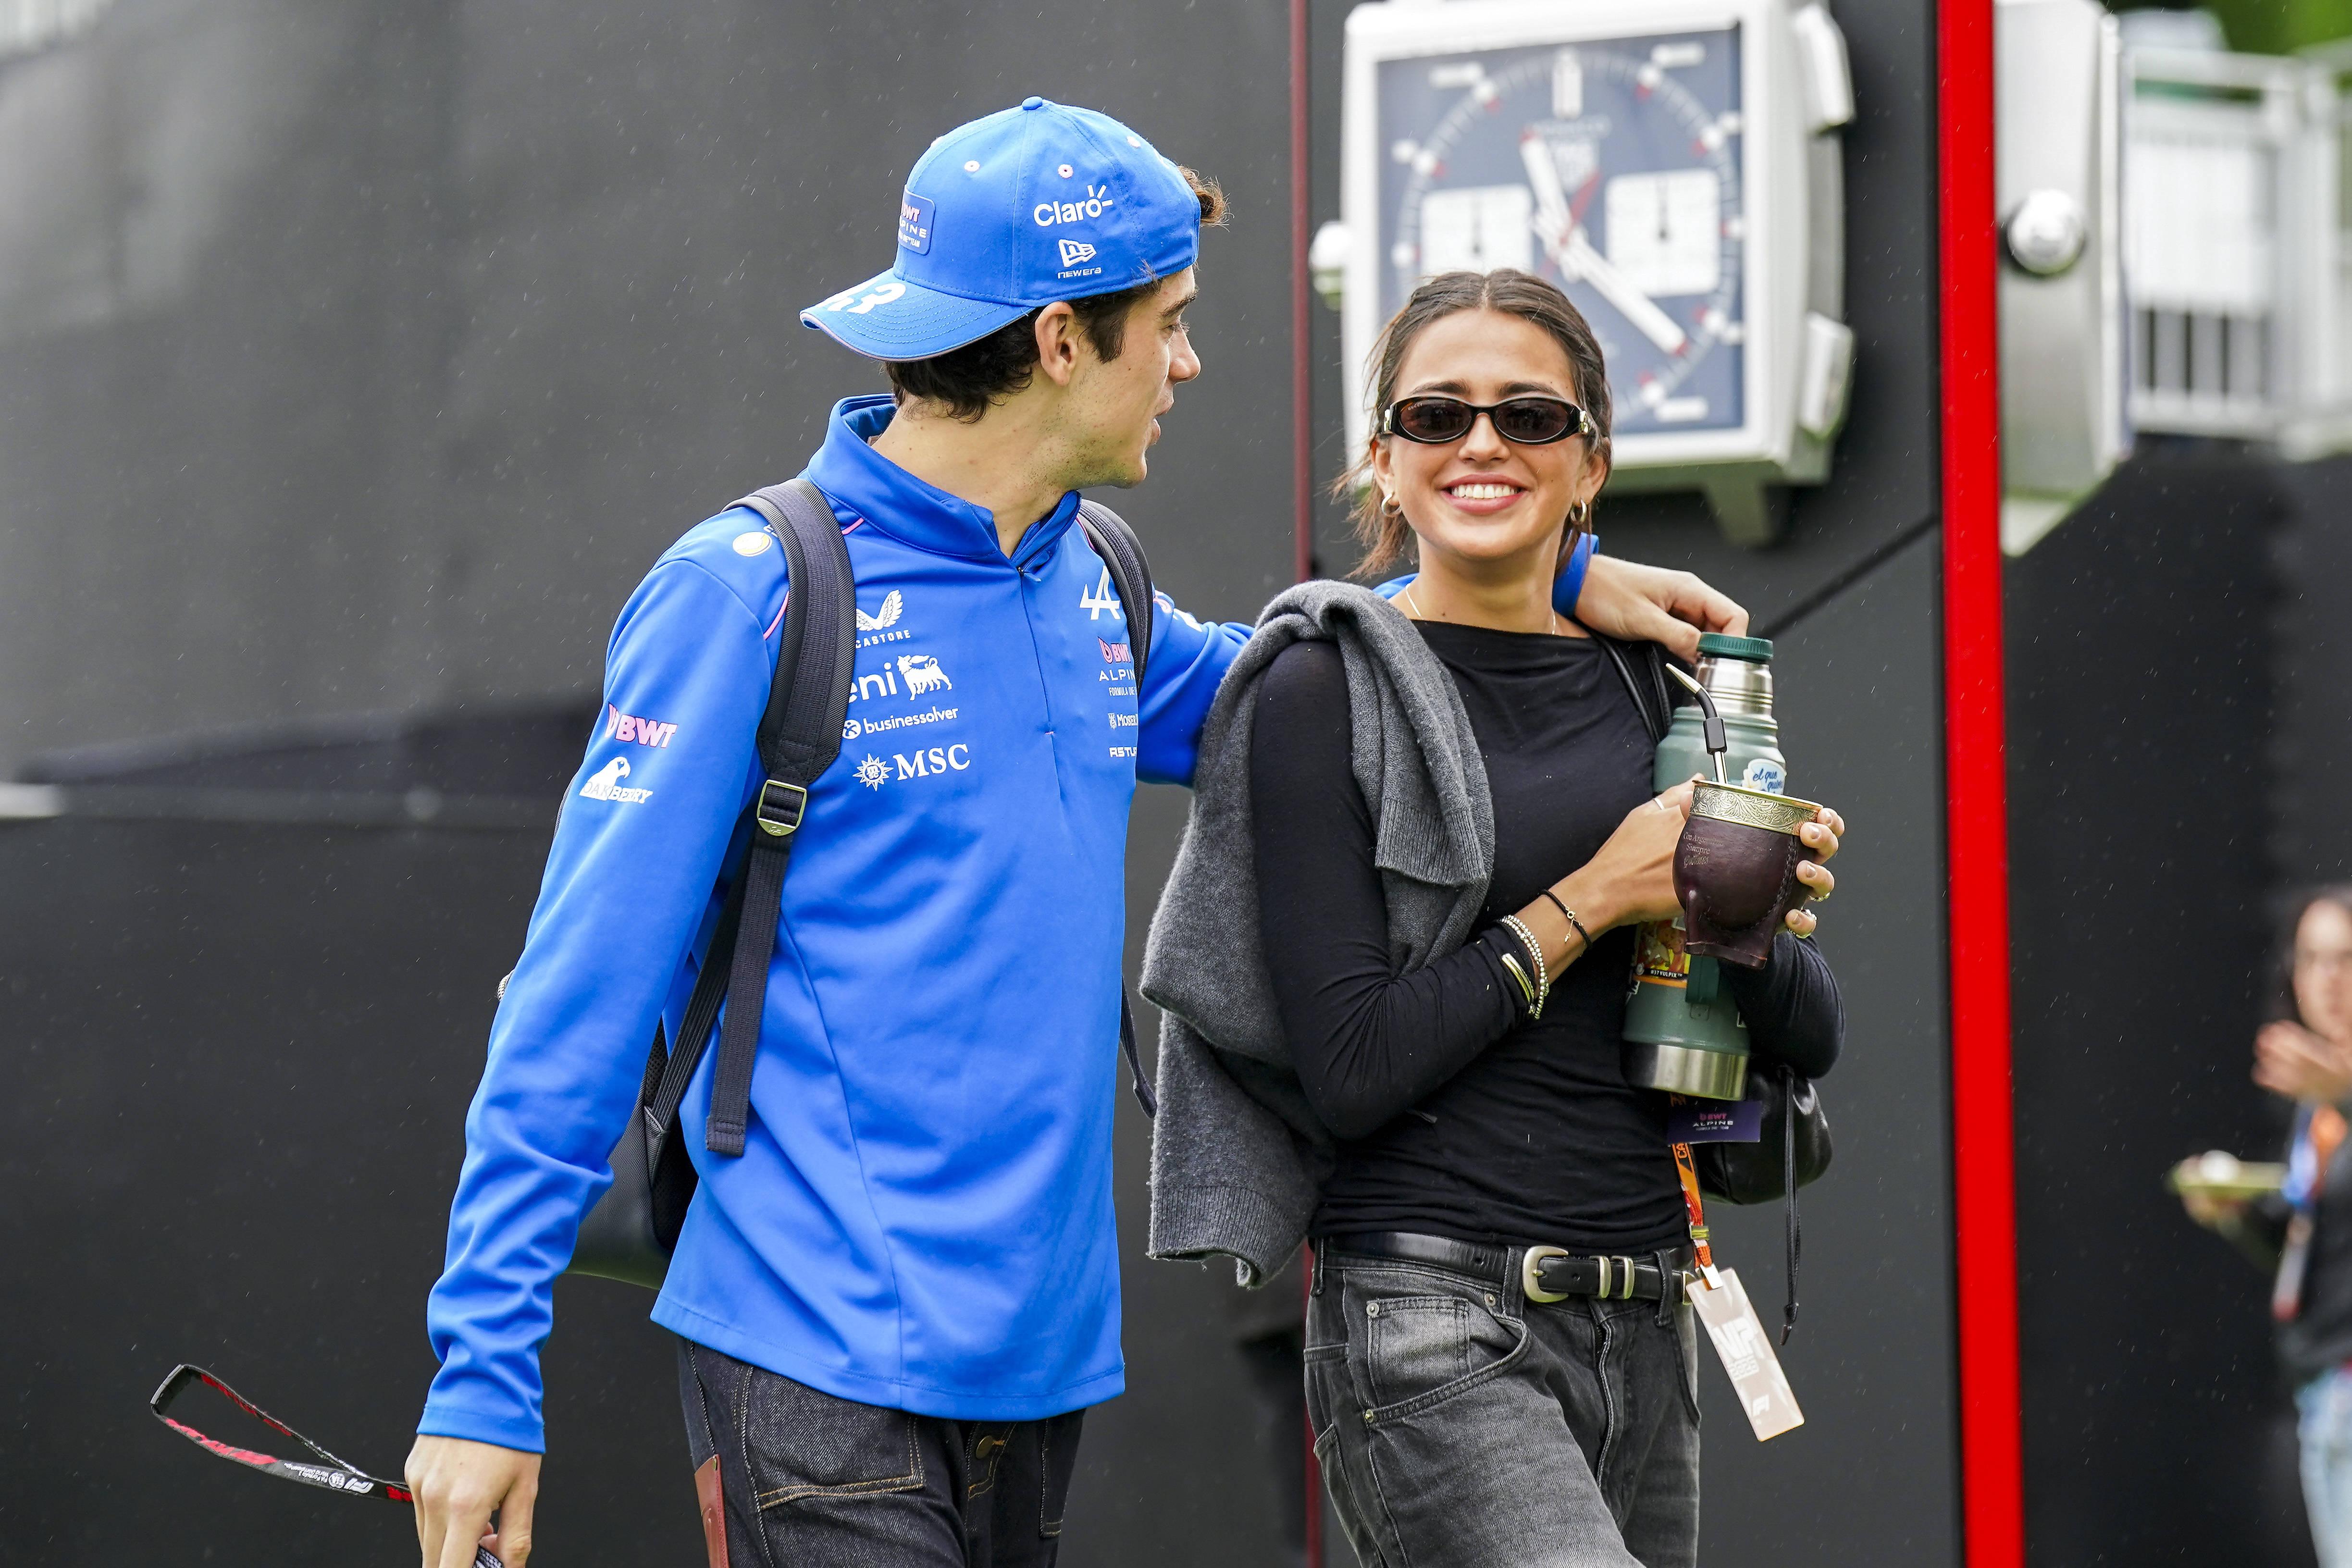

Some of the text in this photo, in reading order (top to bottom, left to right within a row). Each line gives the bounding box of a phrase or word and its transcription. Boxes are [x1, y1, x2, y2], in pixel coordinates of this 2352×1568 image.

[1034, 198, 1102, 227] Claro
[899, 216, 927, 238] PINE
[855, 630, 912, 649] CASTORE
[1111, 643, 1131, 663] BWT
[1109, 687, 1128, 696] FORMULA
[615, 714, 678, 748] BWT
[863, 706, 958, 734] businessolver
[892, 743, 970, 781] MSC
[1686, 843, 1710, 854] Siempre
